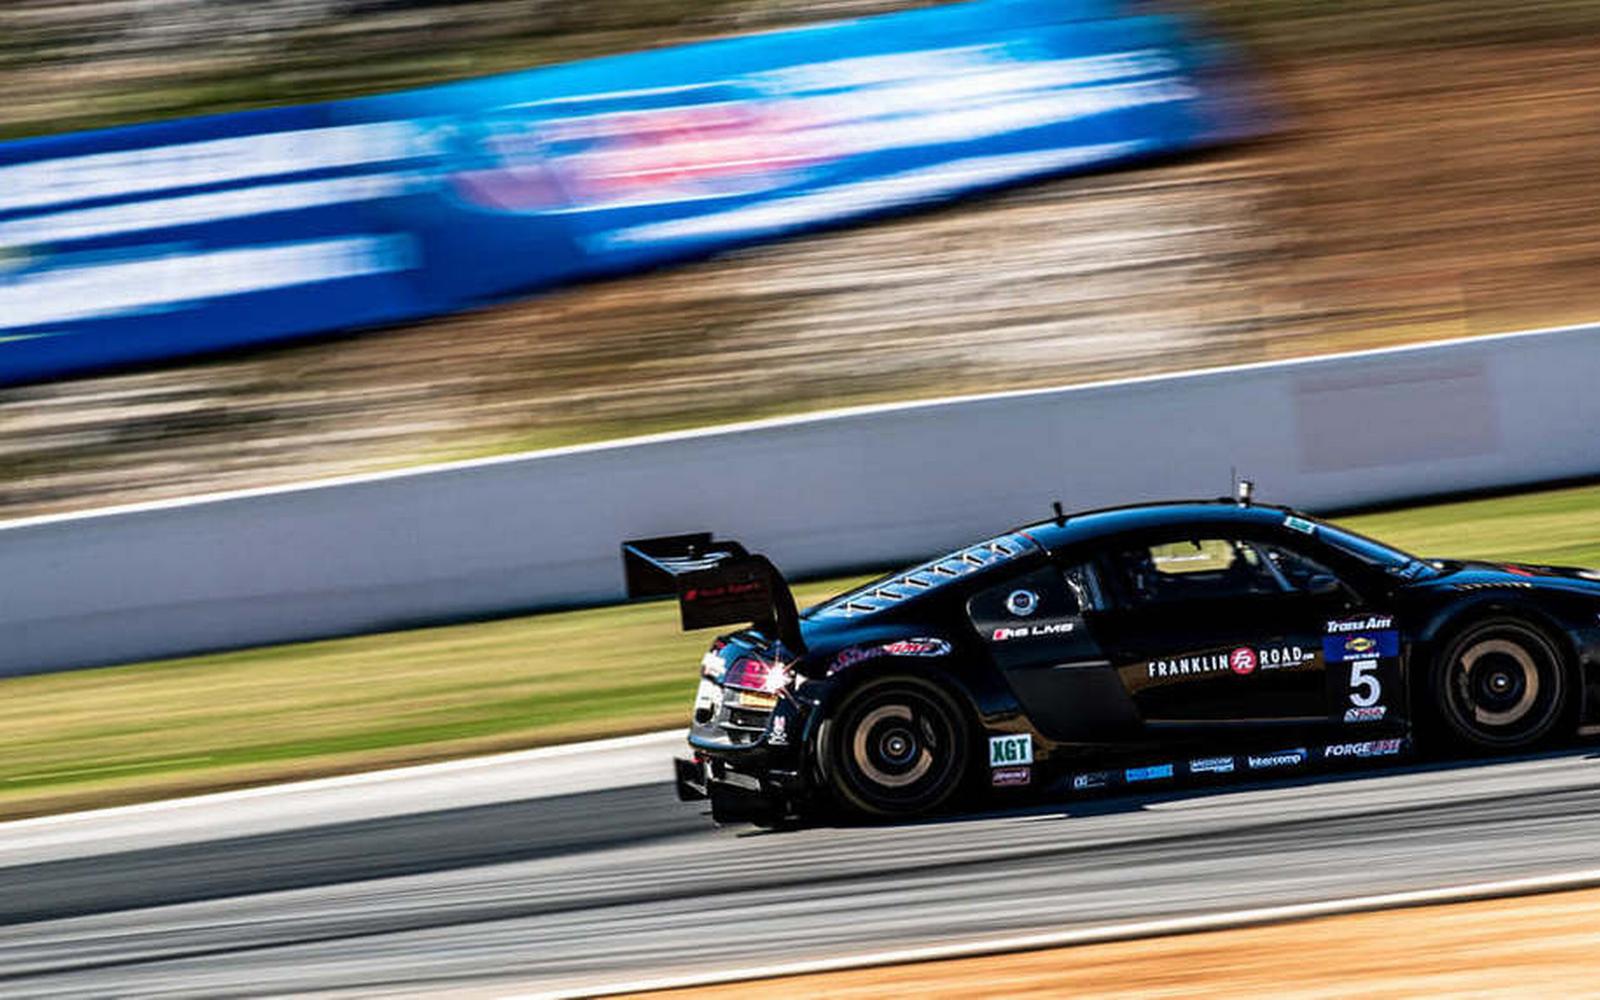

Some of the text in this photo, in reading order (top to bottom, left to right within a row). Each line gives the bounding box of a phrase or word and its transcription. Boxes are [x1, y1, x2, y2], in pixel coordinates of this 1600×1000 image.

[1032, 623, 1074, 636] LMS
[1327, 617, 1392, 633] Trans Am
[1149, 654, 1229, 677] FRANKLIN
[1350, 660, 1381, 707] 5
[993, 739, 1029, 762] XGT
[1248, 753, 1302, 769] Intercomp
